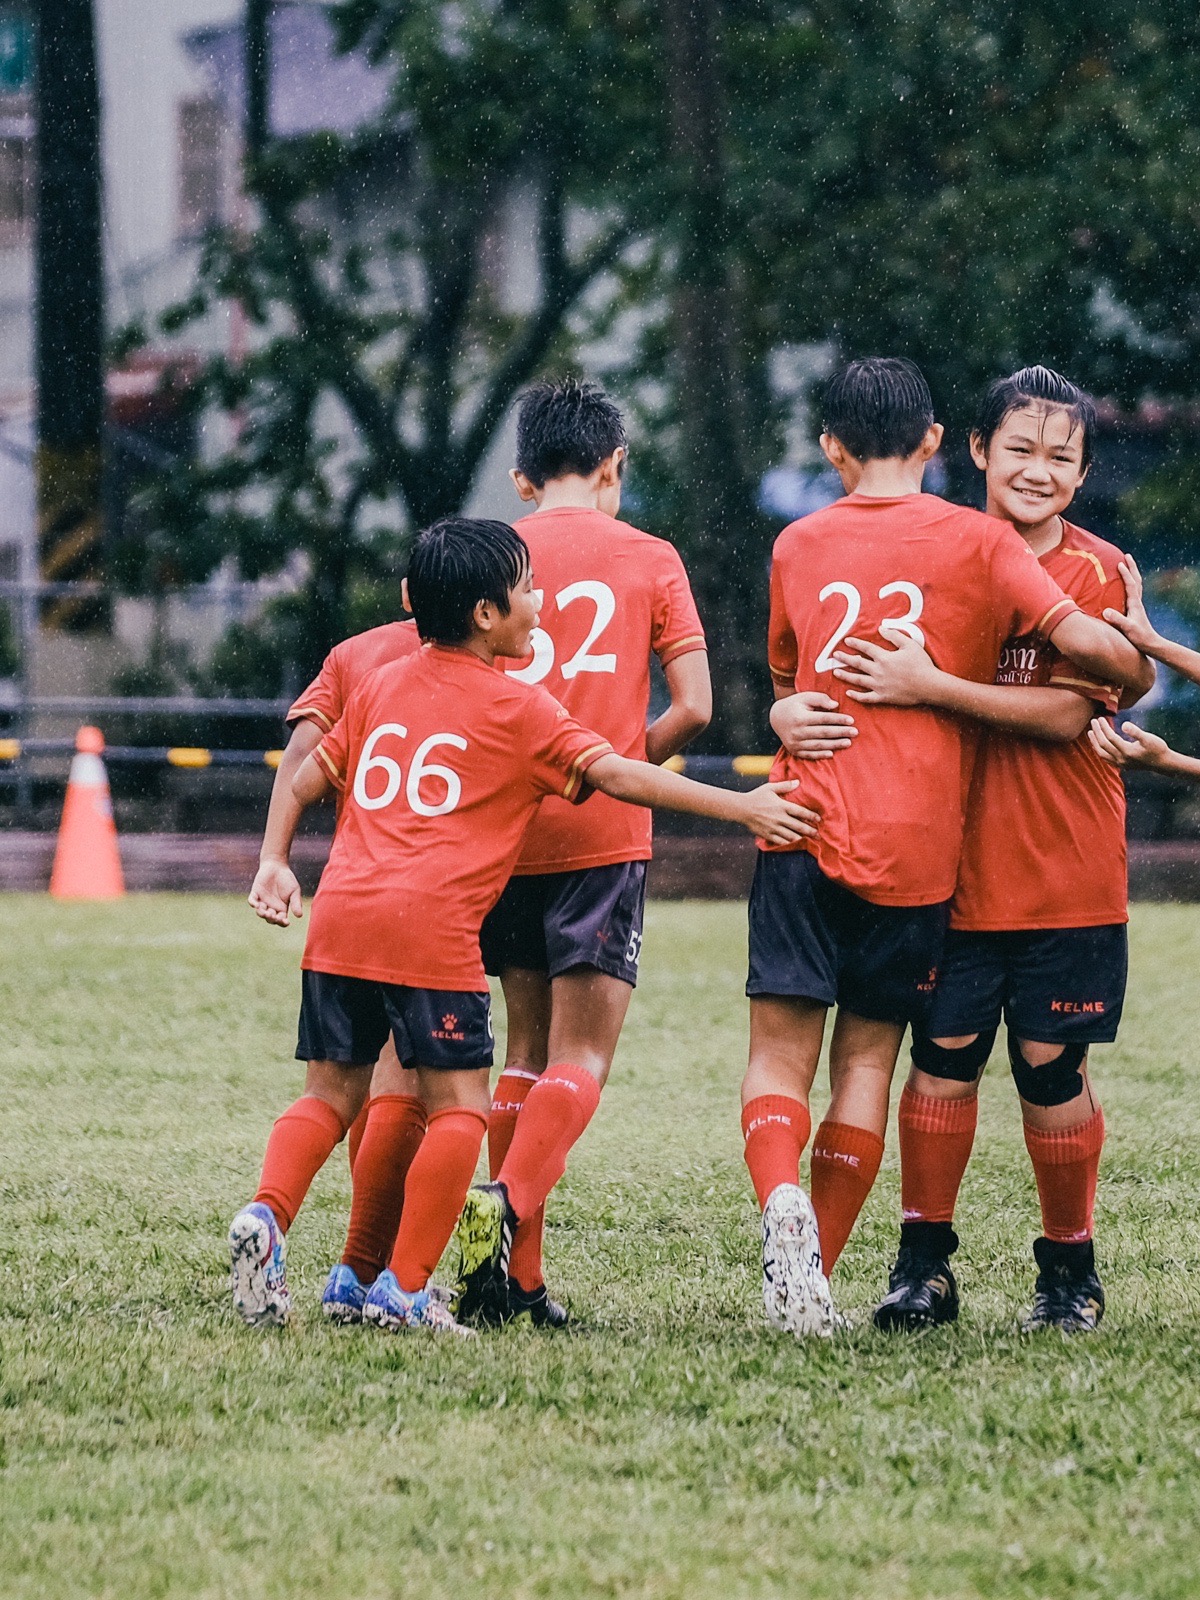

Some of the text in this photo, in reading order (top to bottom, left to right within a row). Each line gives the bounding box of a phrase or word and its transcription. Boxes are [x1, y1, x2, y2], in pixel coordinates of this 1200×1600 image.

[814, 580, 925, 673] 23
[353, 722, 468, 817] 66
[1050, 1000, 1105, 1013] KELME
[431, 1029, 465, 1041] KELME
